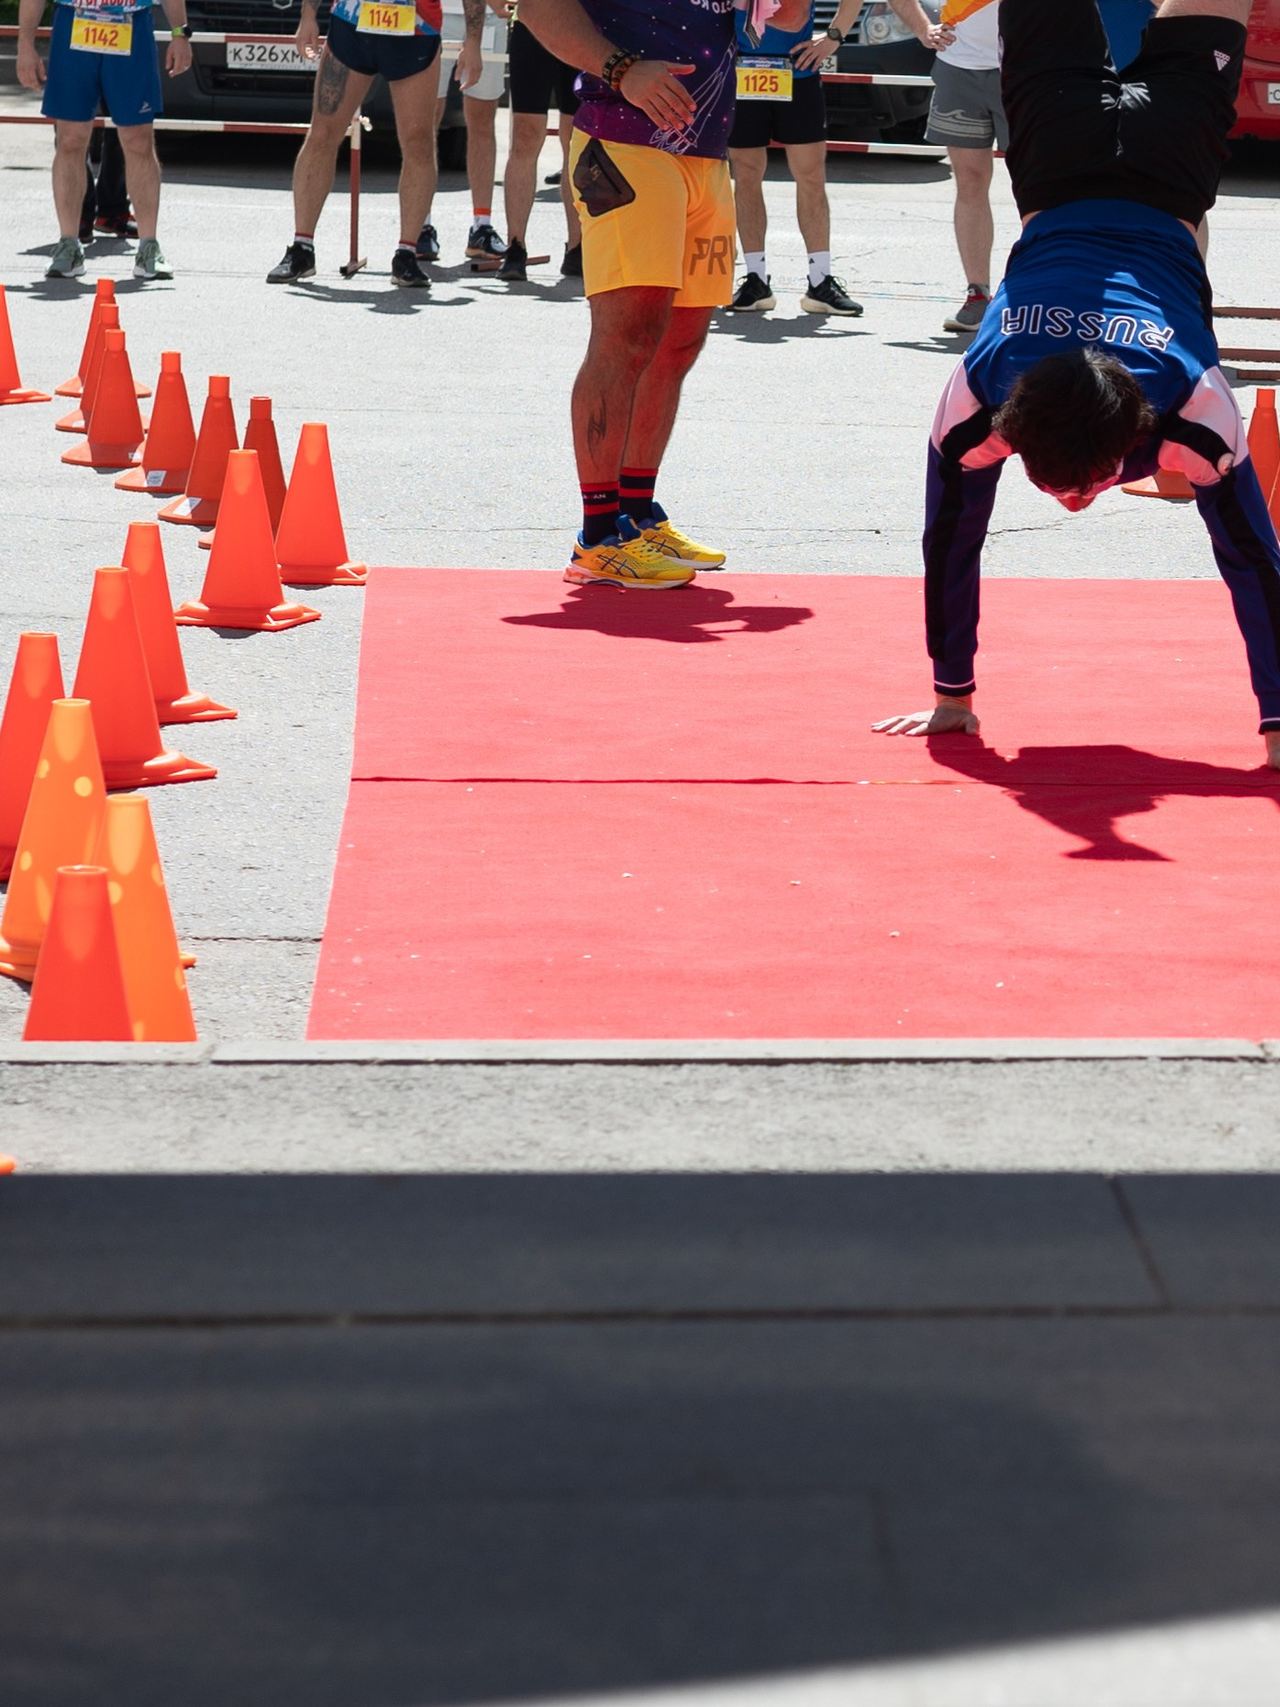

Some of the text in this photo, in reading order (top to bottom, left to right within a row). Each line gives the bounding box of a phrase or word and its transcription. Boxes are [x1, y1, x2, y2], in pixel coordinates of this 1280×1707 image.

[369, 9, 400, 28] 1141
[83, 26, 119, 47] 1142
[744, 74, 779, 93] 1125
[1000, 304, 1175, 352] RUSSIA
